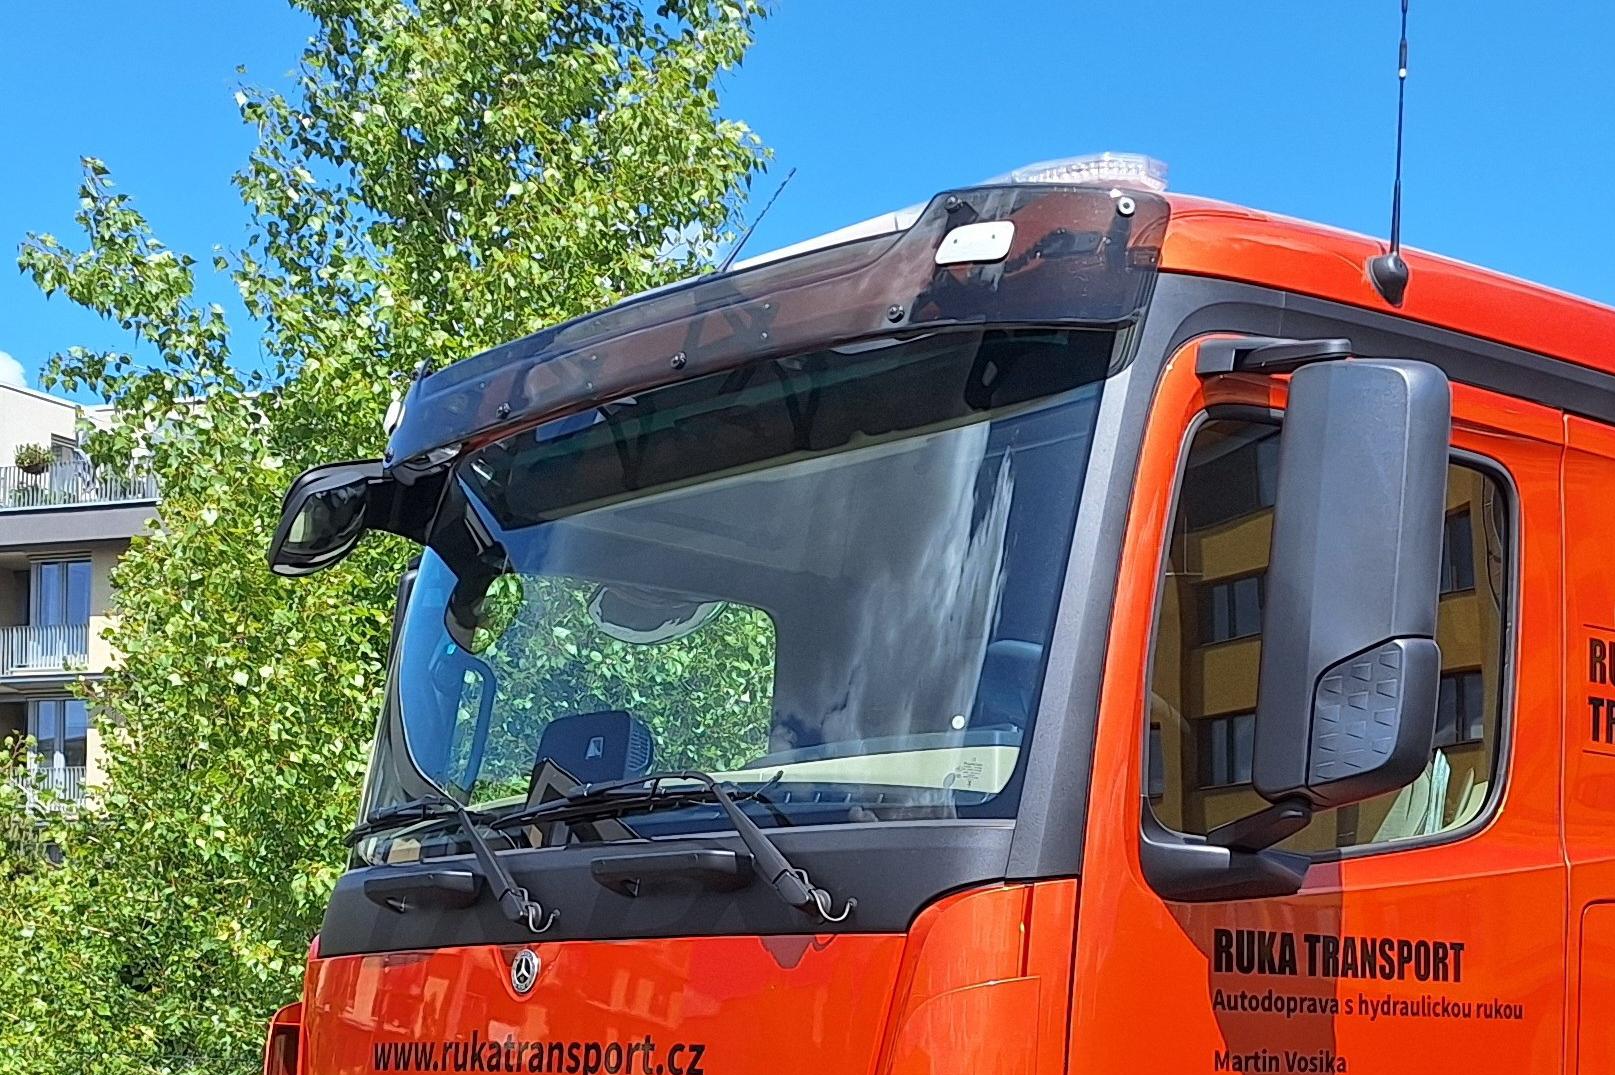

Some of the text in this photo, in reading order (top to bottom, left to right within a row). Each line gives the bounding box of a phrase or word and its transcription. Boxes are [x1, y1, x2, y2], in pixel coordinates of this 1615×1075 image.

[1213, 928, 1465, 983] RUKA TRANSPORT
[1212, 988, 1524, 1022] Autodoprava s hydraulickou rukou
[1213, 1048, 1347, 1074] Martin Vosika
